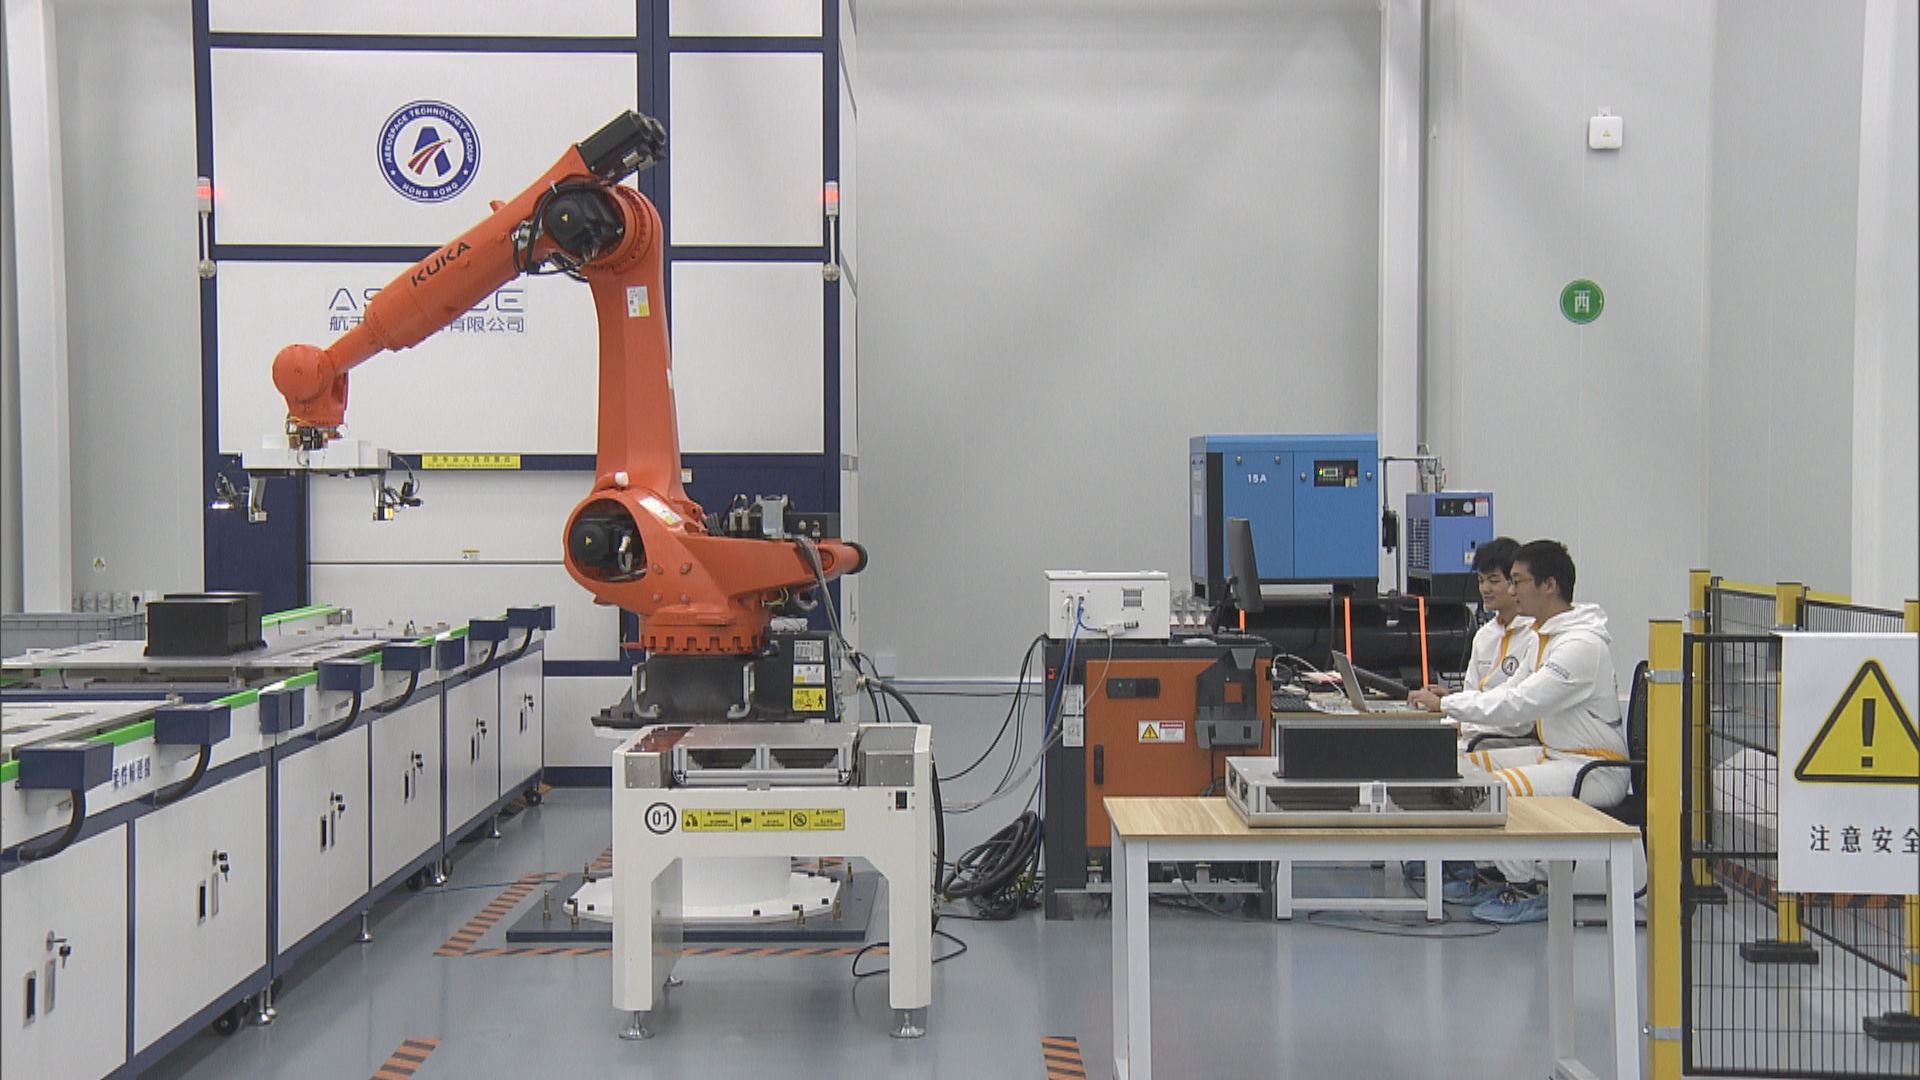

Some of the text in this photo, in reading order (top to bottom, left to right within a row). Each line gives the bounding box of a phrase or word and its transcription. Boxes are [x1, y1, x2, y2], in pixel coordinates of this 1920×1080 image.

[384, 106, 475, 163] AEROSPACE TECHNOLOGY GROUP
[402, 182, 459, 197] HONG KONG
[411, 241, 471, 287] KUKA
[1574, 290, 1591, 313] 西
[1248, 474, 1267, 483] 15A
[652, 810, 670, 826] 01
[1810, 824, 1919, 853] 注意安全
